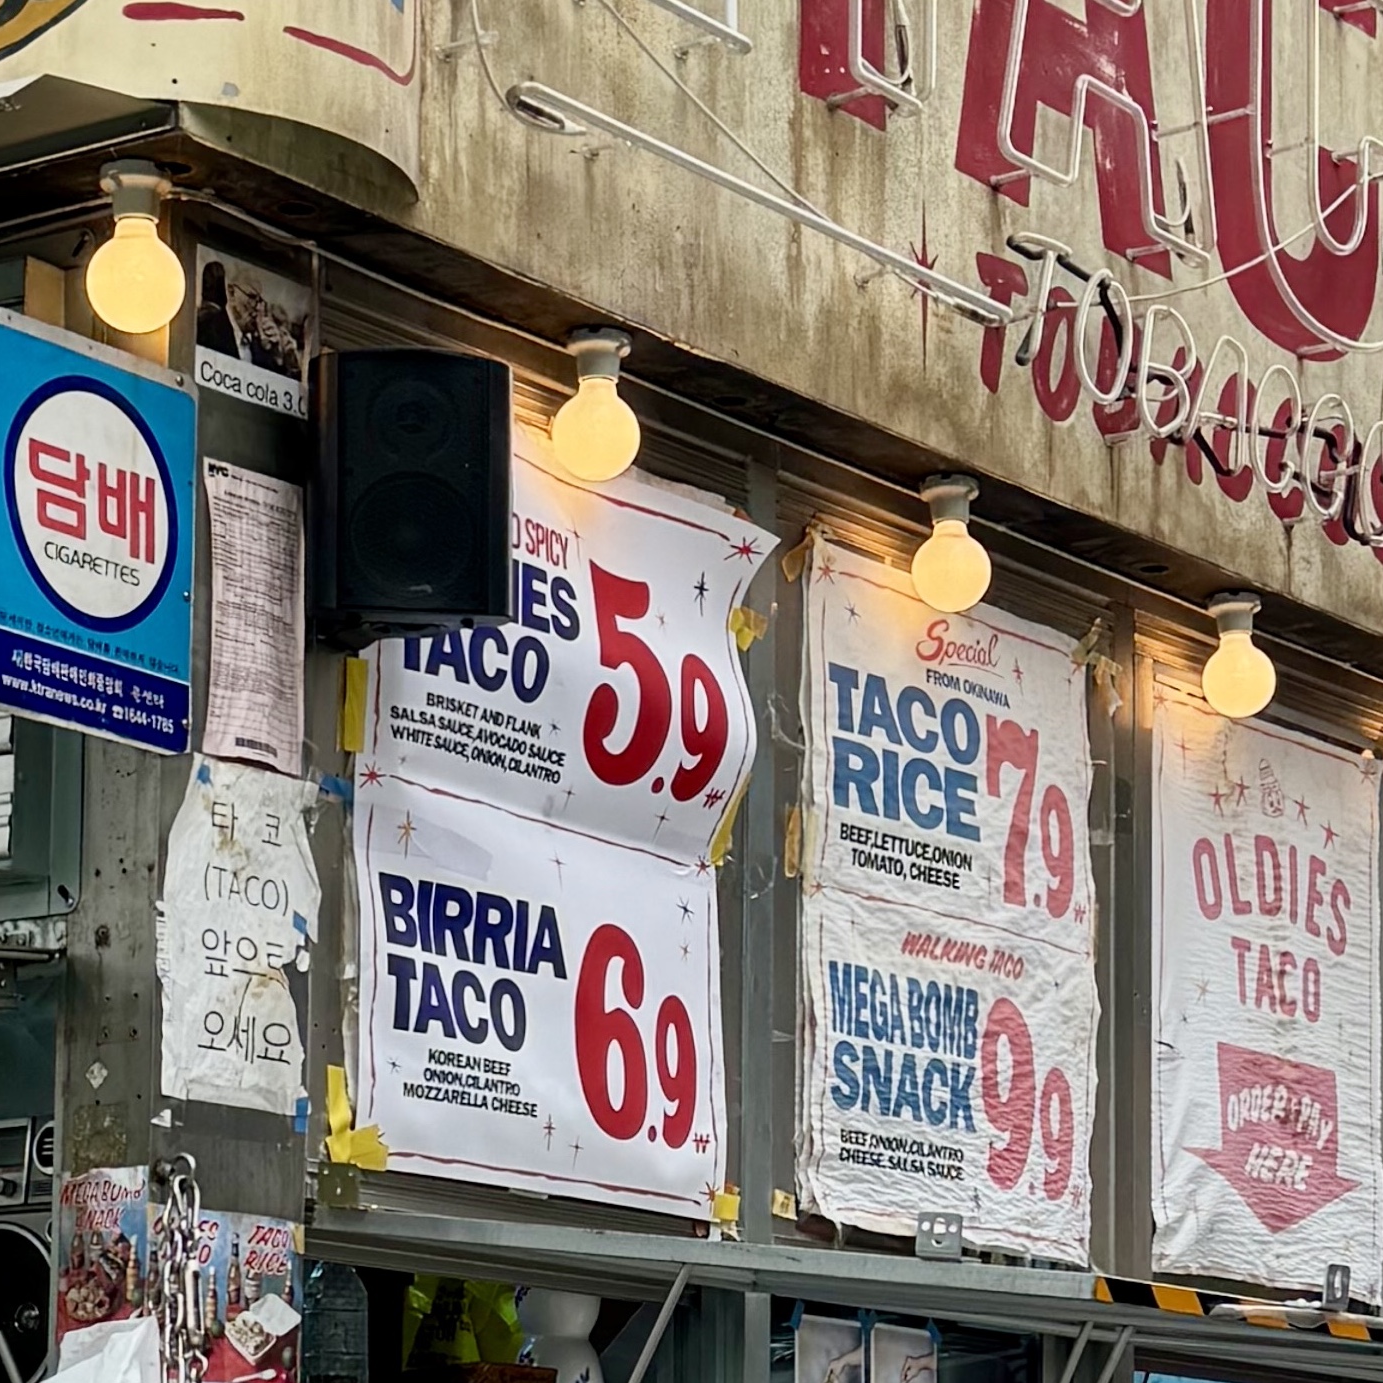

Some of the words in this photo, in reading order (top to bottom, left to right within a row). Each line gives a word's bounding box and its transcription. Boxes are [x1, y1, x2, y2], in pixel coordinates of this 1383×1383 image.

[201, 361, 242, 394] Coca
[247, 383, 278, 407] cola
[28, 437, 155, 564] 담배
[44, 540, 141, 587] CIGARETTES
[525, 518, 568, 570] SPICY
[402, 626, 549, 703] TACO
[916, 619, 1001, 668] Special
[583, 559, 728, 802] 5.9
[925, 669, 961, 692] FROM
[963, 680, 1010, 709] OKINAWA
[390, 705, 436, 730] SALSA
[528, 739, 566, 768] SAUCE
[391, 724, 434, 747] WHITE
[427, 692, 479, 719] BRISKET
[480, 704, 506, 727] AND
[507, 711, 542, 740] FLANK
[828, 661, 980, 765] TACO
[832, 736, 981, 842] RICE
[985, 714, 1075, 919] 7.9
[205, 862, 288, 917] (TACO)
[851, 848, 908, 880] TOMATO,
[909, 862, 960, 890] CHEESE
[1192, 833, 1351, 957] OLDIES
[378, 871, 567, 980] BIRRIA
[902, 931, 988, 969] WALKING
[989, 948, 1024, 981] TACO
[1230, 936, 1322, 1023] TACO
[387, 953, 526, 1052] TACO
[828, 960, 906, 1045] MEGA
[907, 976, 979, 1060] BOMB
[197, 1011, 291, 1065] 오세요
[428, 1048, 480, 1074] KOREAN
[483, 1056, 511, 1077] BEEF
[574, 923, 698, 1149] 6.9
[402, 1082, 489, 1111] MOZZARELLA
[491, 1098, 538, 1118] CHEESE
[830, 1040, 977, 1134] SNACK
[981, 997, 1074, 1201] 9.9
[1227, 1084, 1288, 1134] ORDER
[1295, 1100, 1333, 1150] PAY
[1244, 1142, 1314, 1191] HERE
[244, 1249, 288, 1275] RICE
[247, 1225, 290, 1249] TACO
